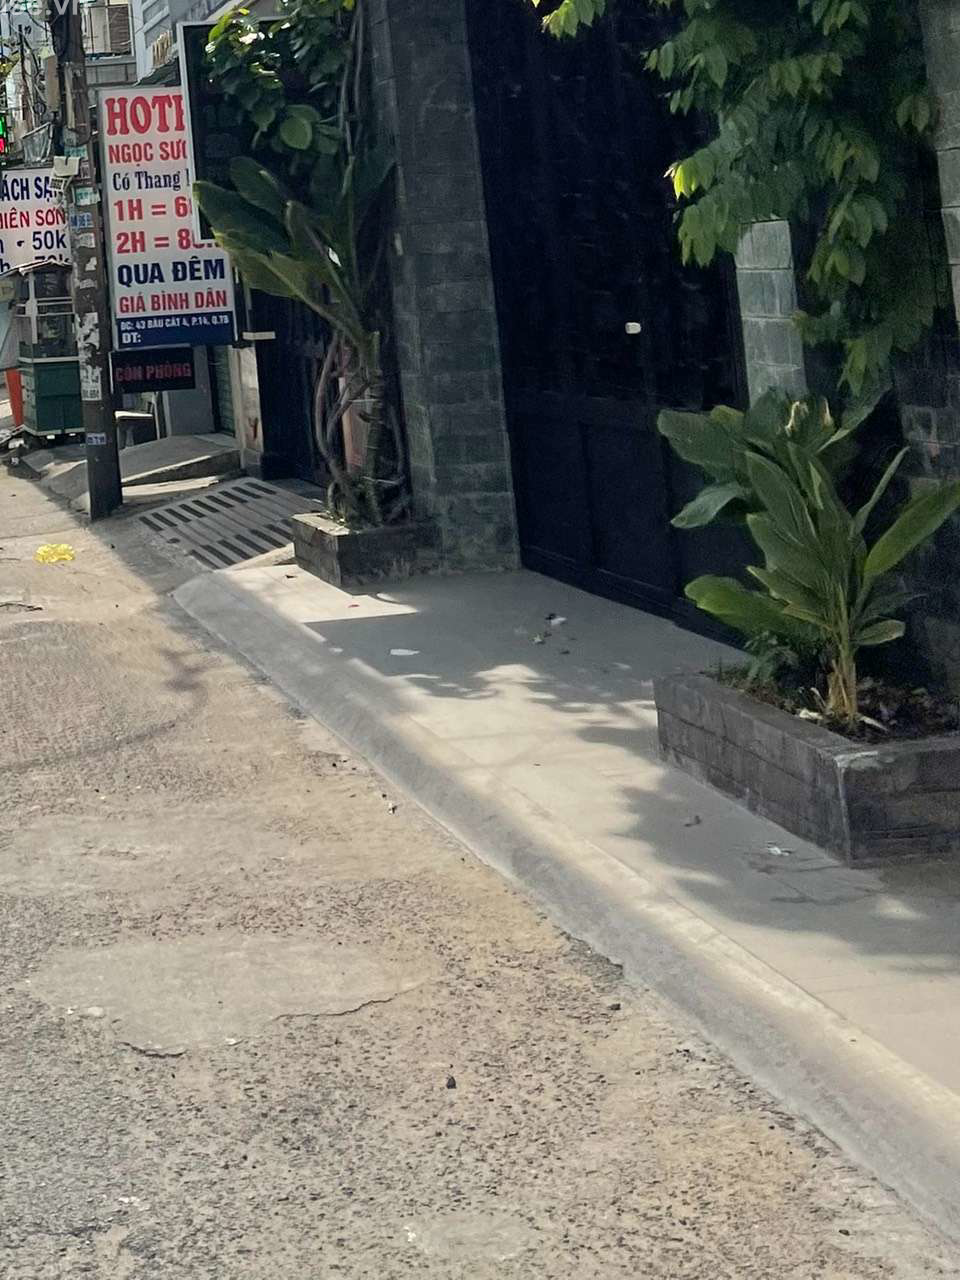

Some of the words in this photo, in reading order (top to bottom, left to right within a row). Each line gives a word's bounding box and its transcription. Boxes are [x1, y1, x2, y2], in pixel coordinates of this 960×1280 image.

[109, 142, 153, 167] NGỌC
[113, 172, 130, 191] Có
[135, 170, 181, 191] Thang
[35, 206, 66, 226] SƠN
[114, 198, 143, 221] 1H
[32, 230, 68, 250] 50k
[116, 231, 146, 254] 2H
[117, 262, 165, 287] QUA
[172, 256, 225, 282] ĐÊM
[119, 292, 146, 314] GIÁ
[151, 290, 189, 312] BÌNH
[194, 287, 228, 308] DÂN
